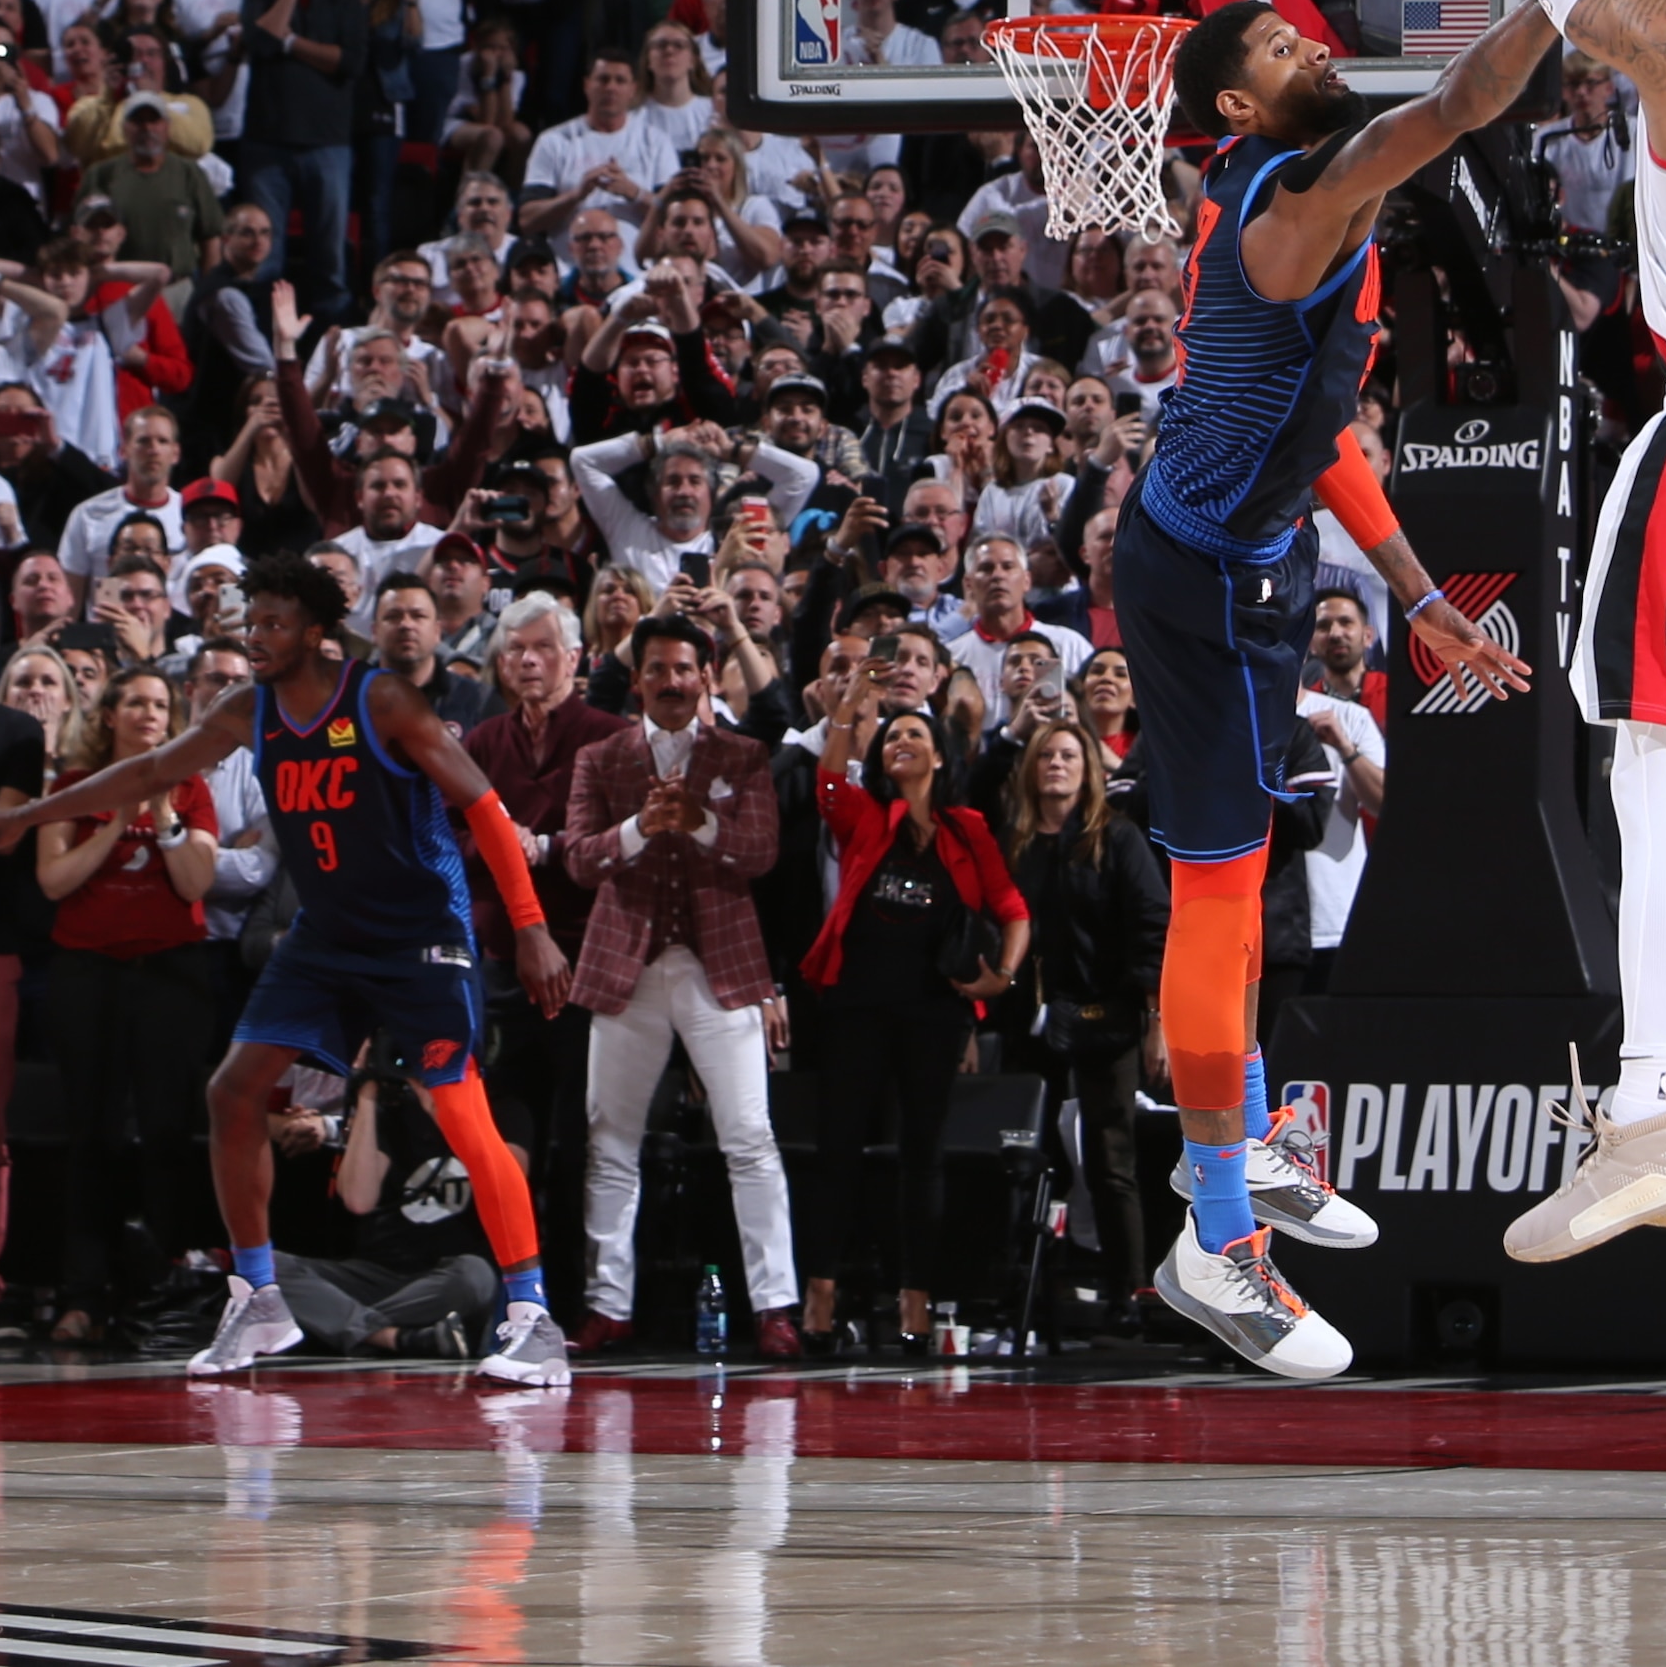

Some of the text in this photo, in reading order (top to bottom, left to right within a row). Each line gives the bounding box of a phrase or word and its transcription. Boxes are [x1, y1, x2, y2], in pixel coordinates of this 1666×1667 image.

[799, 40, 824, 61] NBA
[788, 83, 841, 98] SPALDING
[1400, 439, 1539, 473] SPALDING
[1555, 331, 1575, 671] NBA TV
[275, 756, 361, 813] OKC
[309, 820, 340, 873] 9
[1337, 1083, 1618, 1192] PLAYOFF
